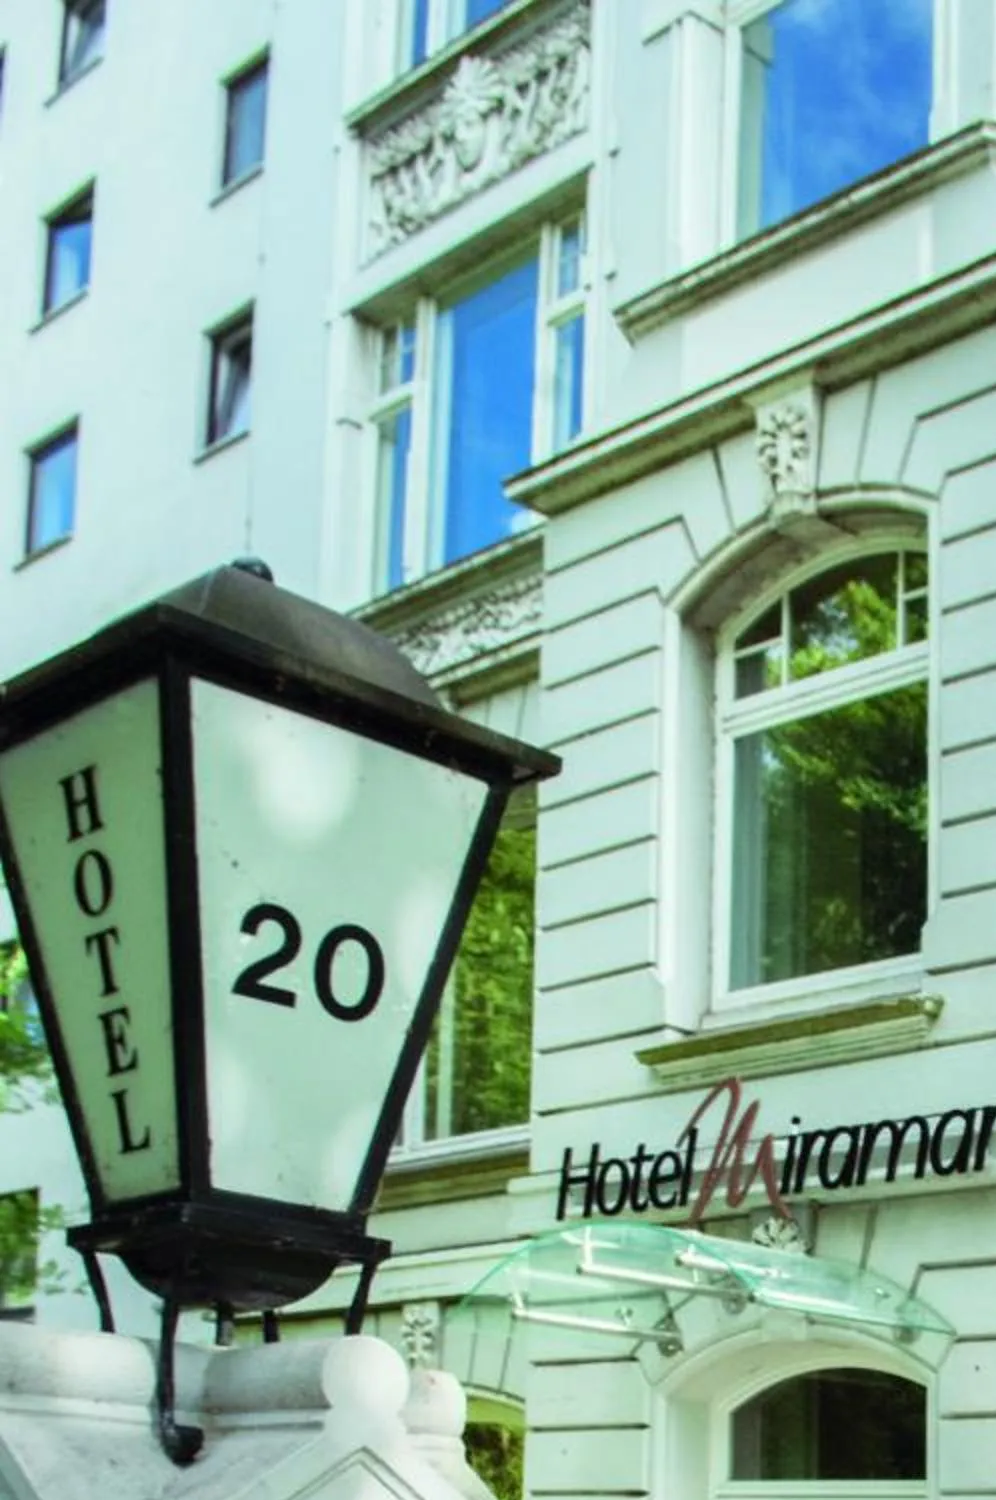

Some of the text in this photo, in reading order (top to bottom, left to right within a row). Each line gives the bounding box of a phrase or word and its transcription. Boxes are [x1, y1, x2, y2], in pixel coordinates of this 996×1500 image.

[58, 765, 150, 1155] HOTEL
[232, 903, 385, 1022] 20
[556, 1126, 698, 1221] Hotel
